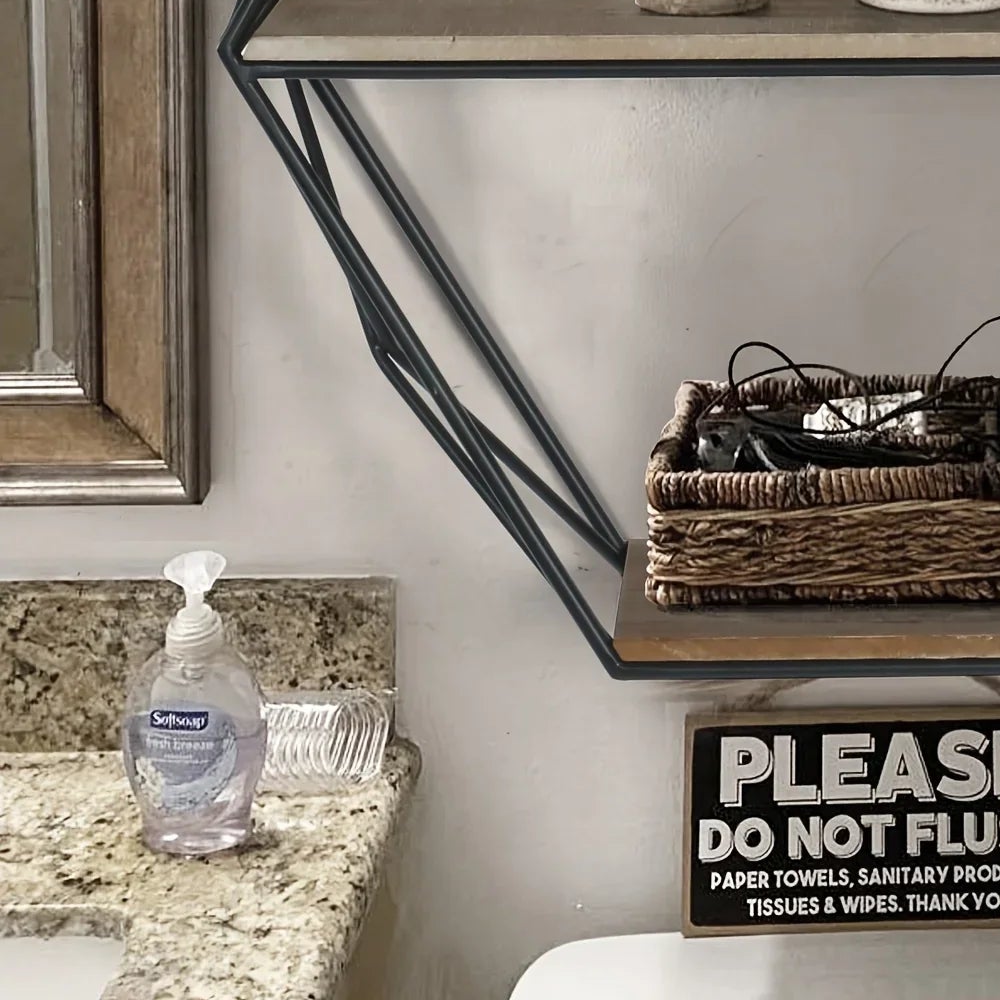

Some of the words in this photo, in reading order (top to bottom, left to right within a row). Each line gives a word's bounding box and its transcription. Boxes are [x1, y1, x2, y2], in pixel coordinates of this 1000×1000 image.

[699, 817, 774, 863] DO
[788, 814, 895, 859] NOT
[711, 871, 769, 889] PAPER
[774, 868, 854, 888] TOWELS,
[858, 866, 948, 885] SANITARY
[747, 897, 819, 917] TISSUES
[824, 896, 836, 914] &
[840, 895, 902, 914] WIPES.
[906, 893, 969, 912] THANK
